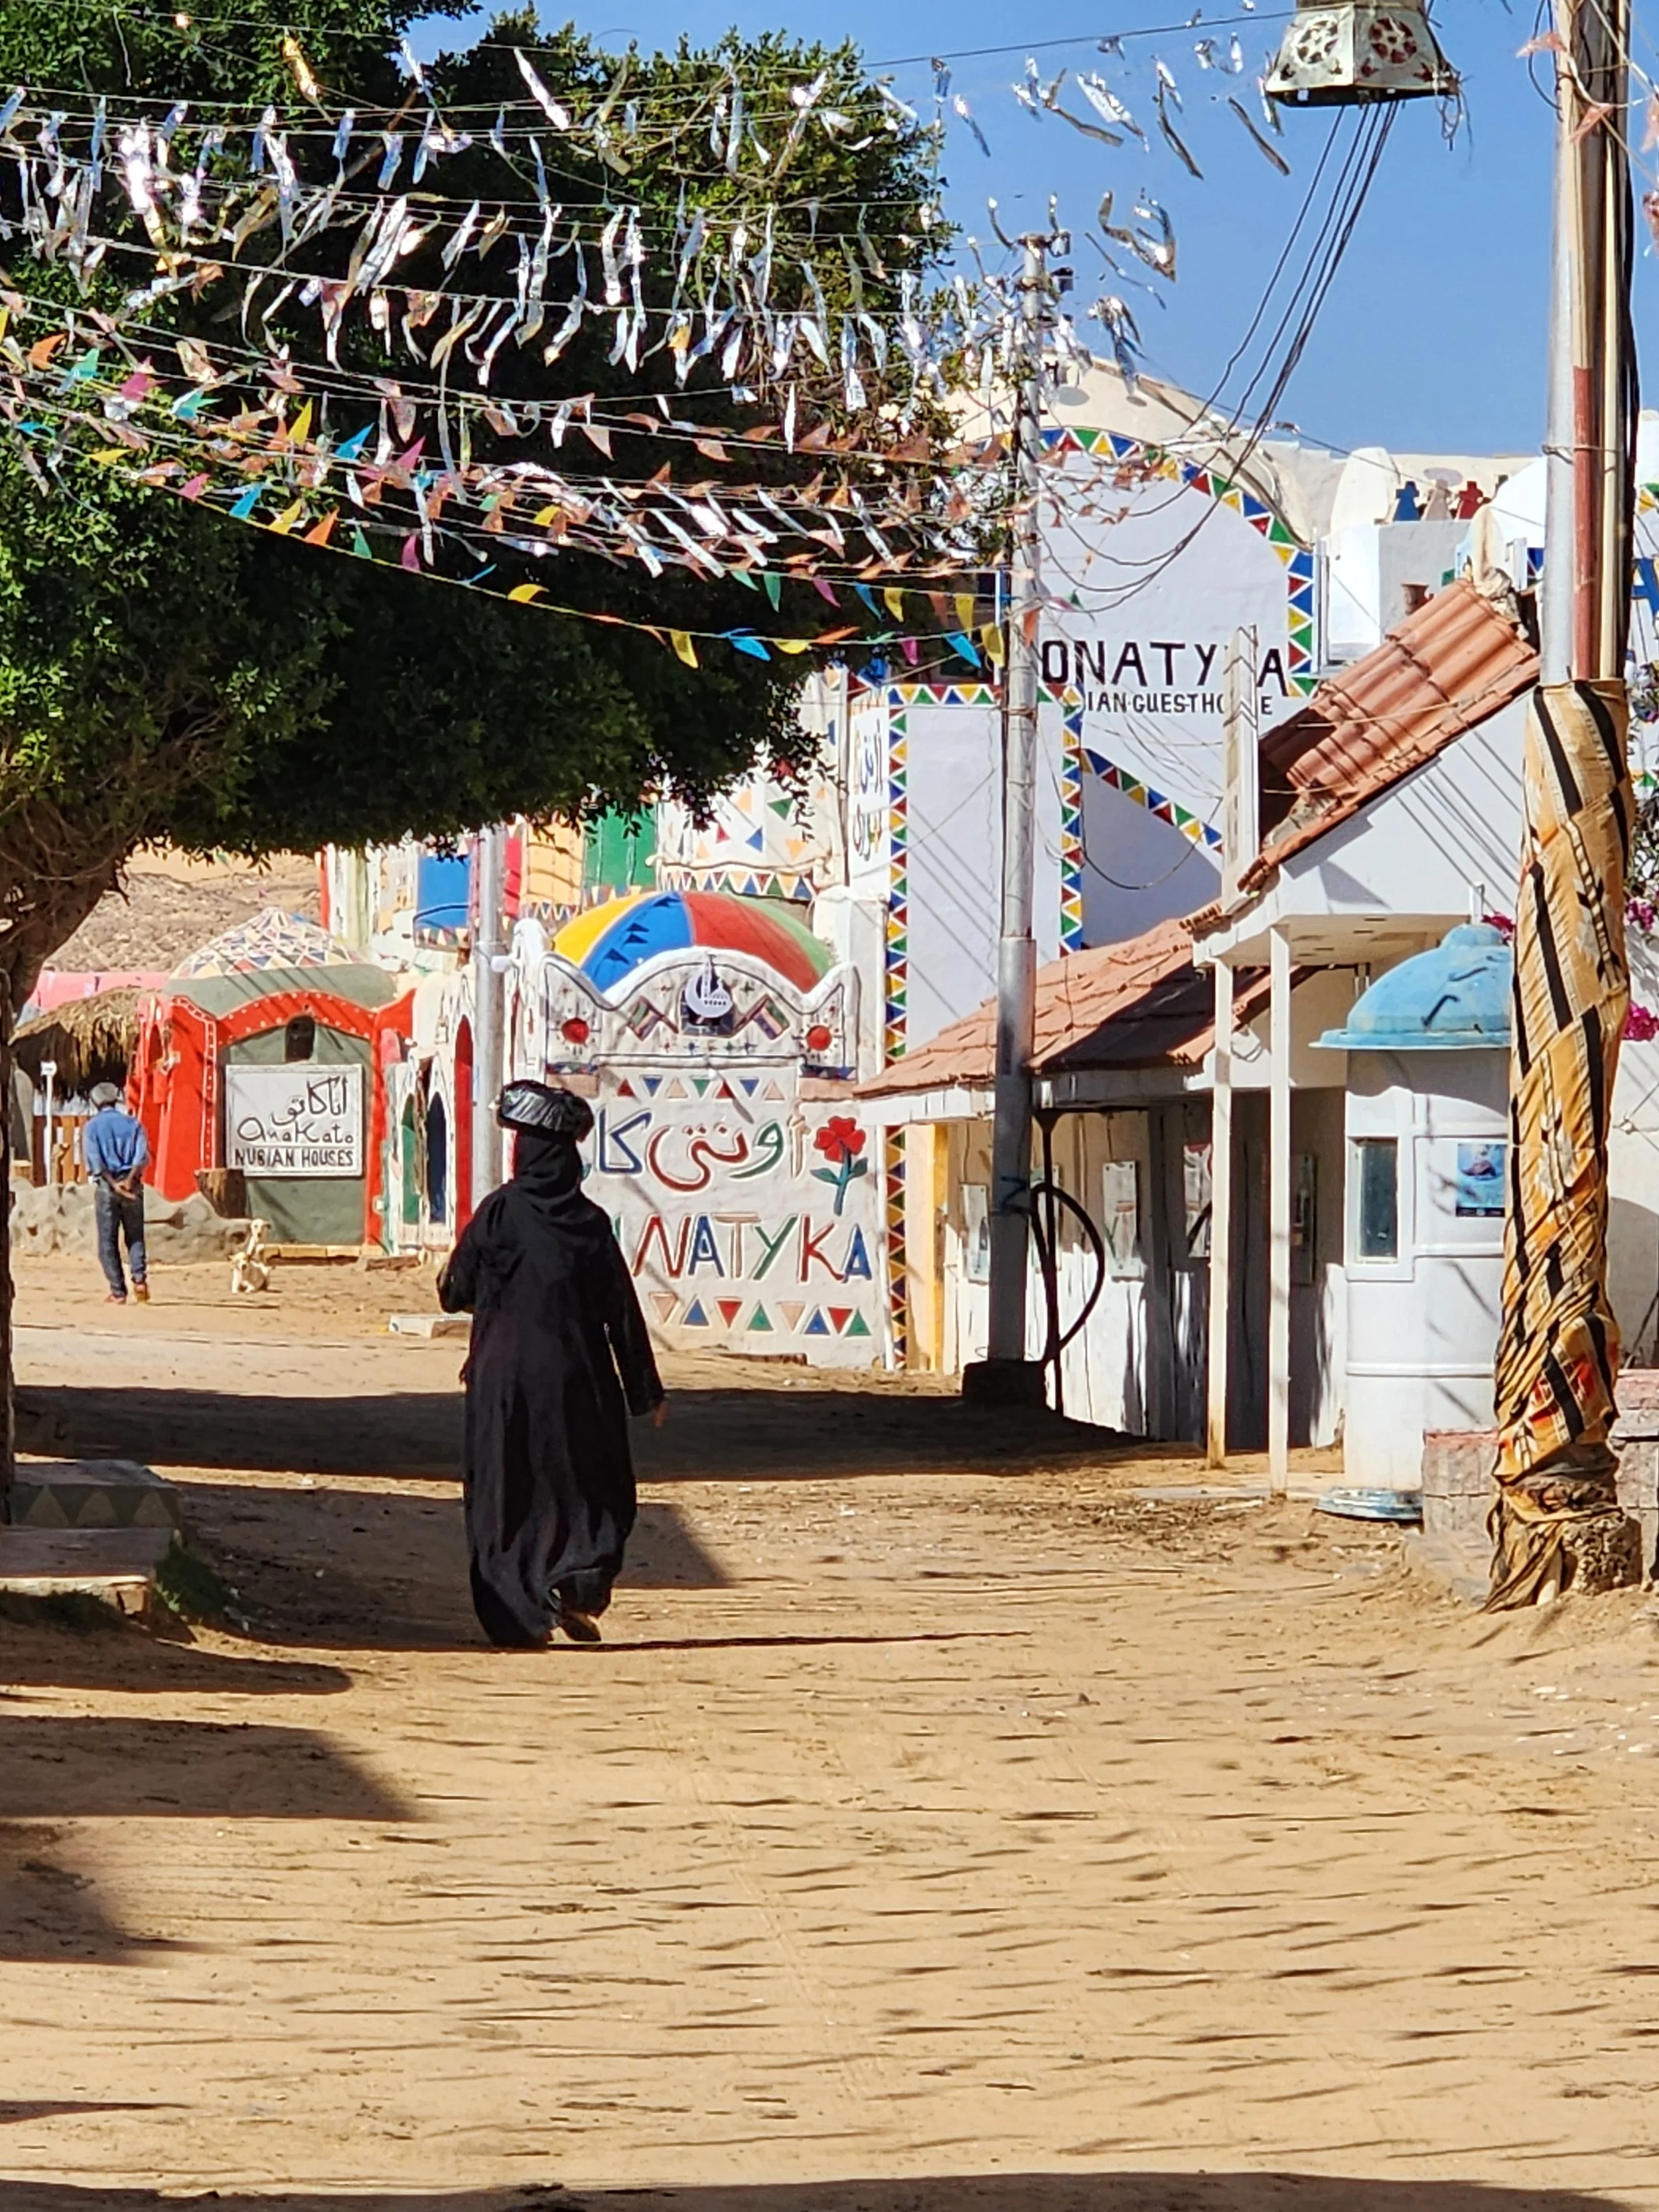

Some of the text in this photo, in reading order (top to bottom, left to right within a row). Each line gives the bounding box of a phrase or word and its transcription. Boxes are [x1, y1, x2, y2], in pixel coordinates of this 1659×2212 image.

[1042, 640, 1288, 696] ONATYA
[235, 1148, 353, 1167] NUBIAN HOUSES
[614, 1215, 873, 1282] NATYKA
